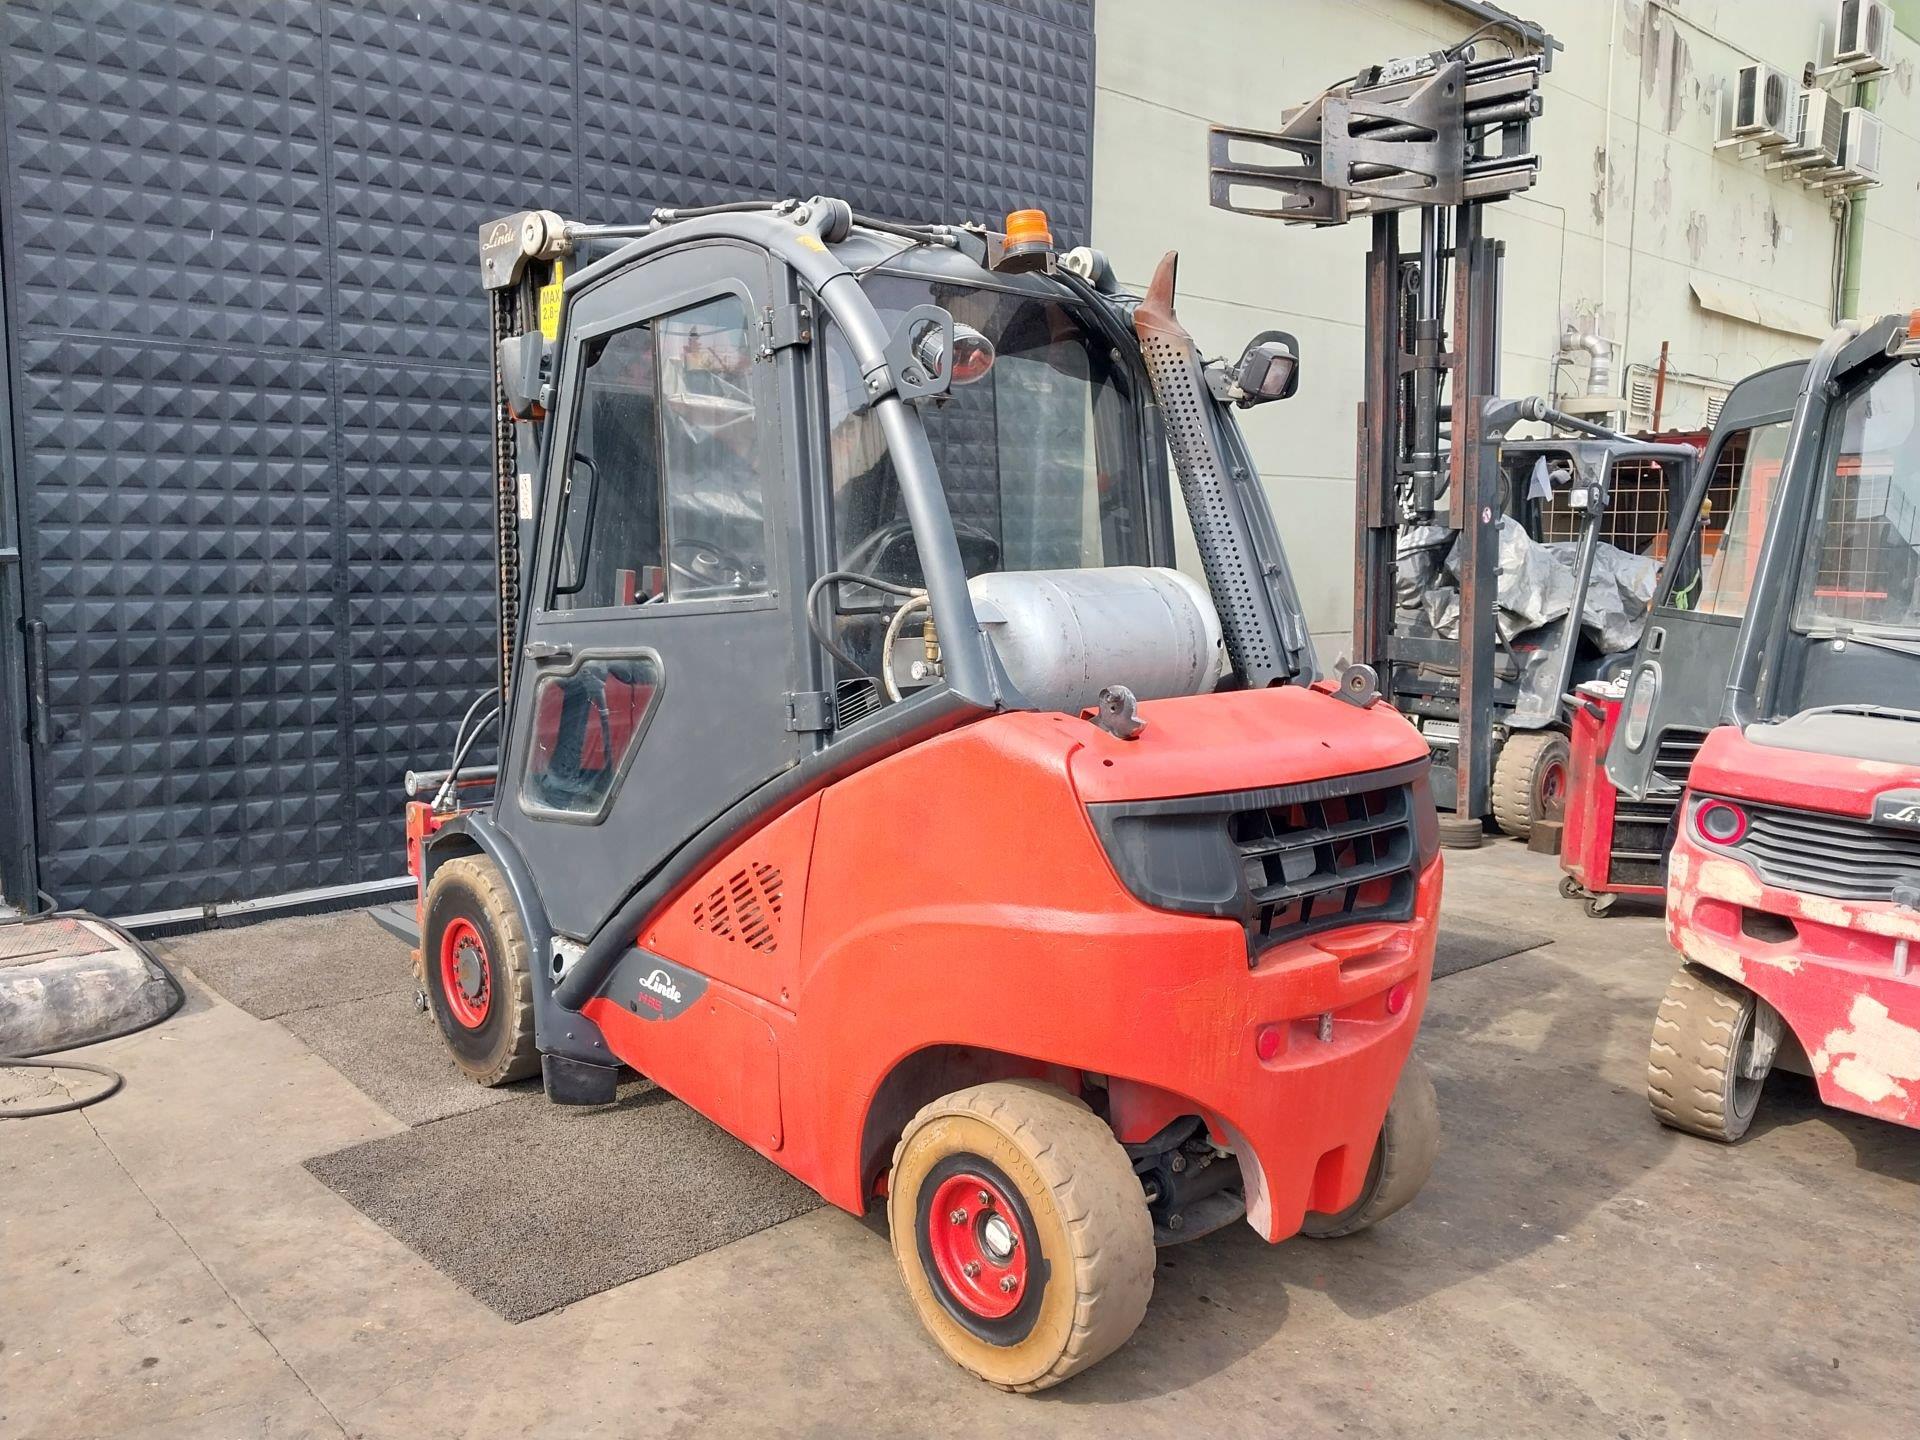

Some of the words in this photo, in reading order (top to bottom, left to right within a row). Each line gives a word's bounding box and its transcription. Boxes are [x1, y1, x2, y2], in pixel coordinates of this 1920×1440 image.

[543, 289, 560, 305] MAX
[638, 969, 682, 1003] Linde
[994, 1135, 1056, 1216] FOCUS
